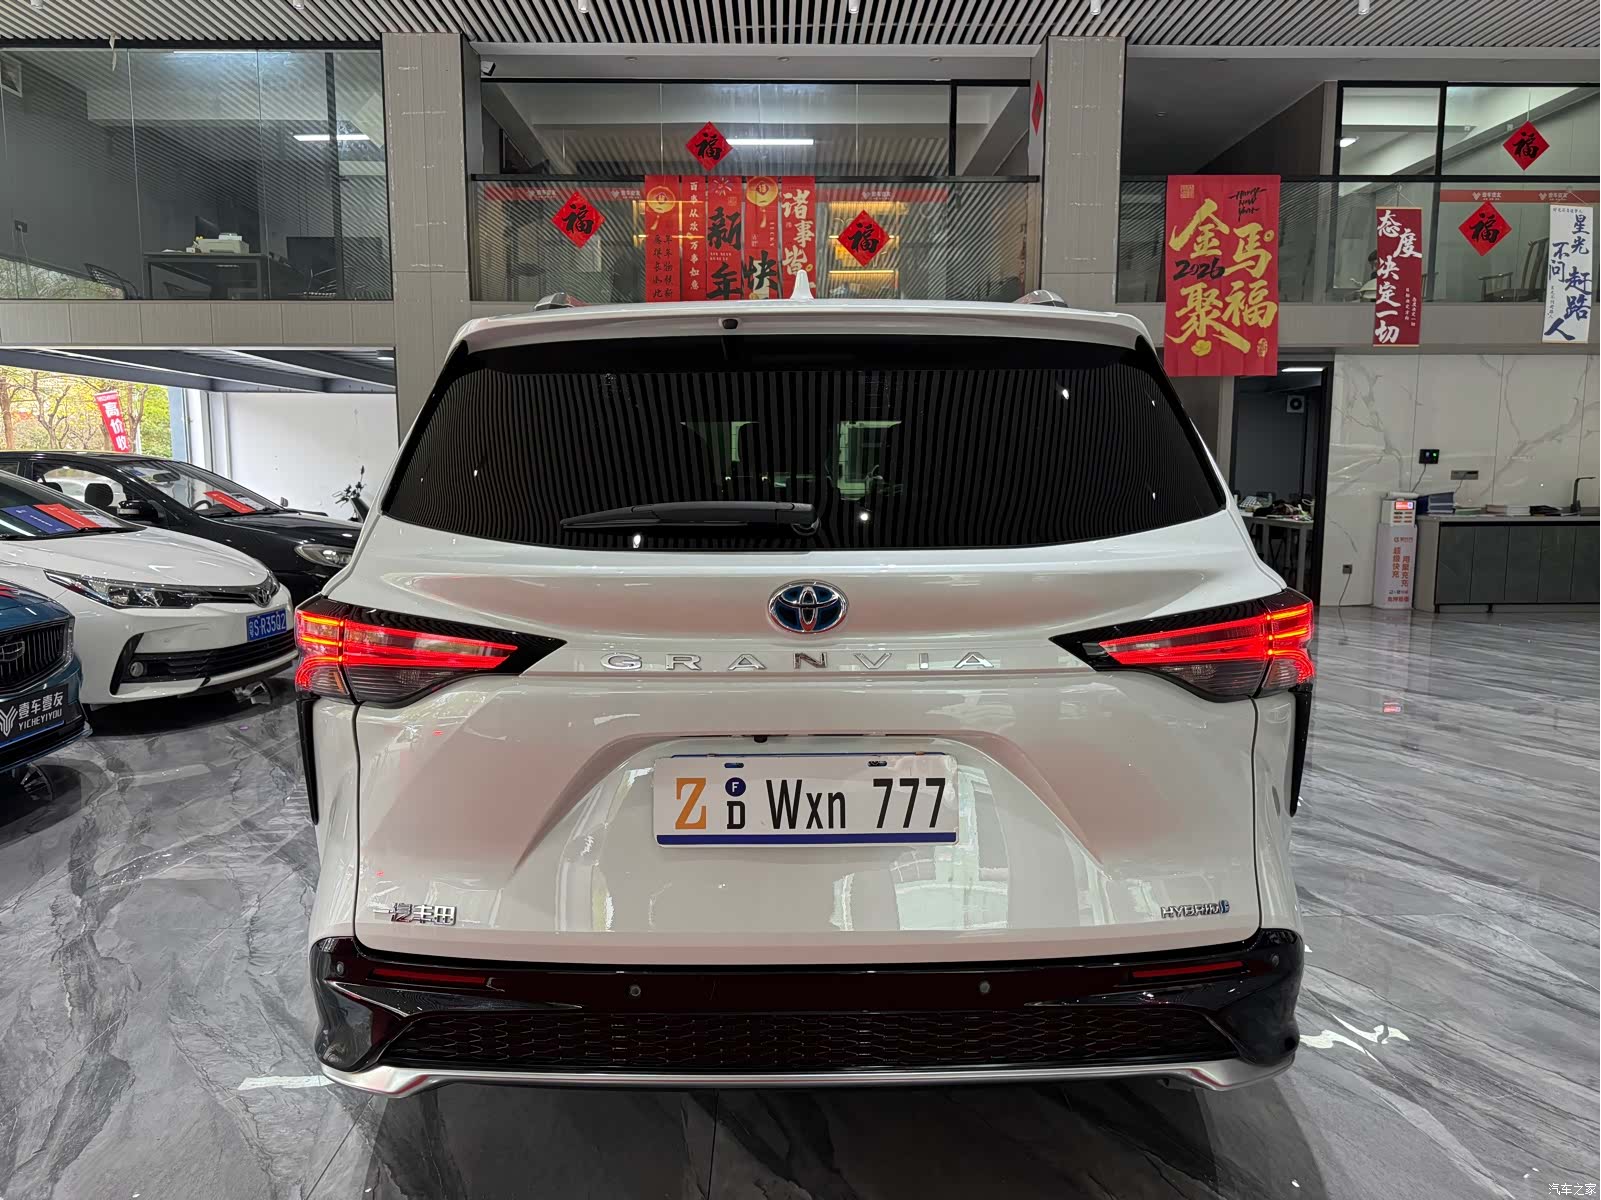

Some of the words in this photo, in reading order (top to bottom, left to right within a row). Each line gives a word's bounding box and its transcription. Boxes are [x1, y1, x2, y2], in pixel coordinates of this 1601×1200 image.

[695, 132, 722, 160] 福
[1513, 132, 1539, 158] 福
[562, 204, 594, 235] 福
[1470, 213, 1500, 243] 福
[781, 189, 816, 288] 诸事皆
[848, 223, 879, 253] 福
[706, 206, 743, 300] 新年
[741, 250, 778, 300] 快
[1173, 257, 1225, 280] 2026
[600, 652, 994, 671] GRANVIA
[19, 692, 63, 719] 壹车壹友
[19, 709, 62, 731] YICHEYIYOU
[675, 778, 706, 829] Z
[727, 801, 745, 829] D
[766, 779, 846, 829] Wxn
[873, 778, 946, 829] 777
[373, 903, 457, 926] 一汽丰田
[1161, 902, 1219, 918] HYBRID
